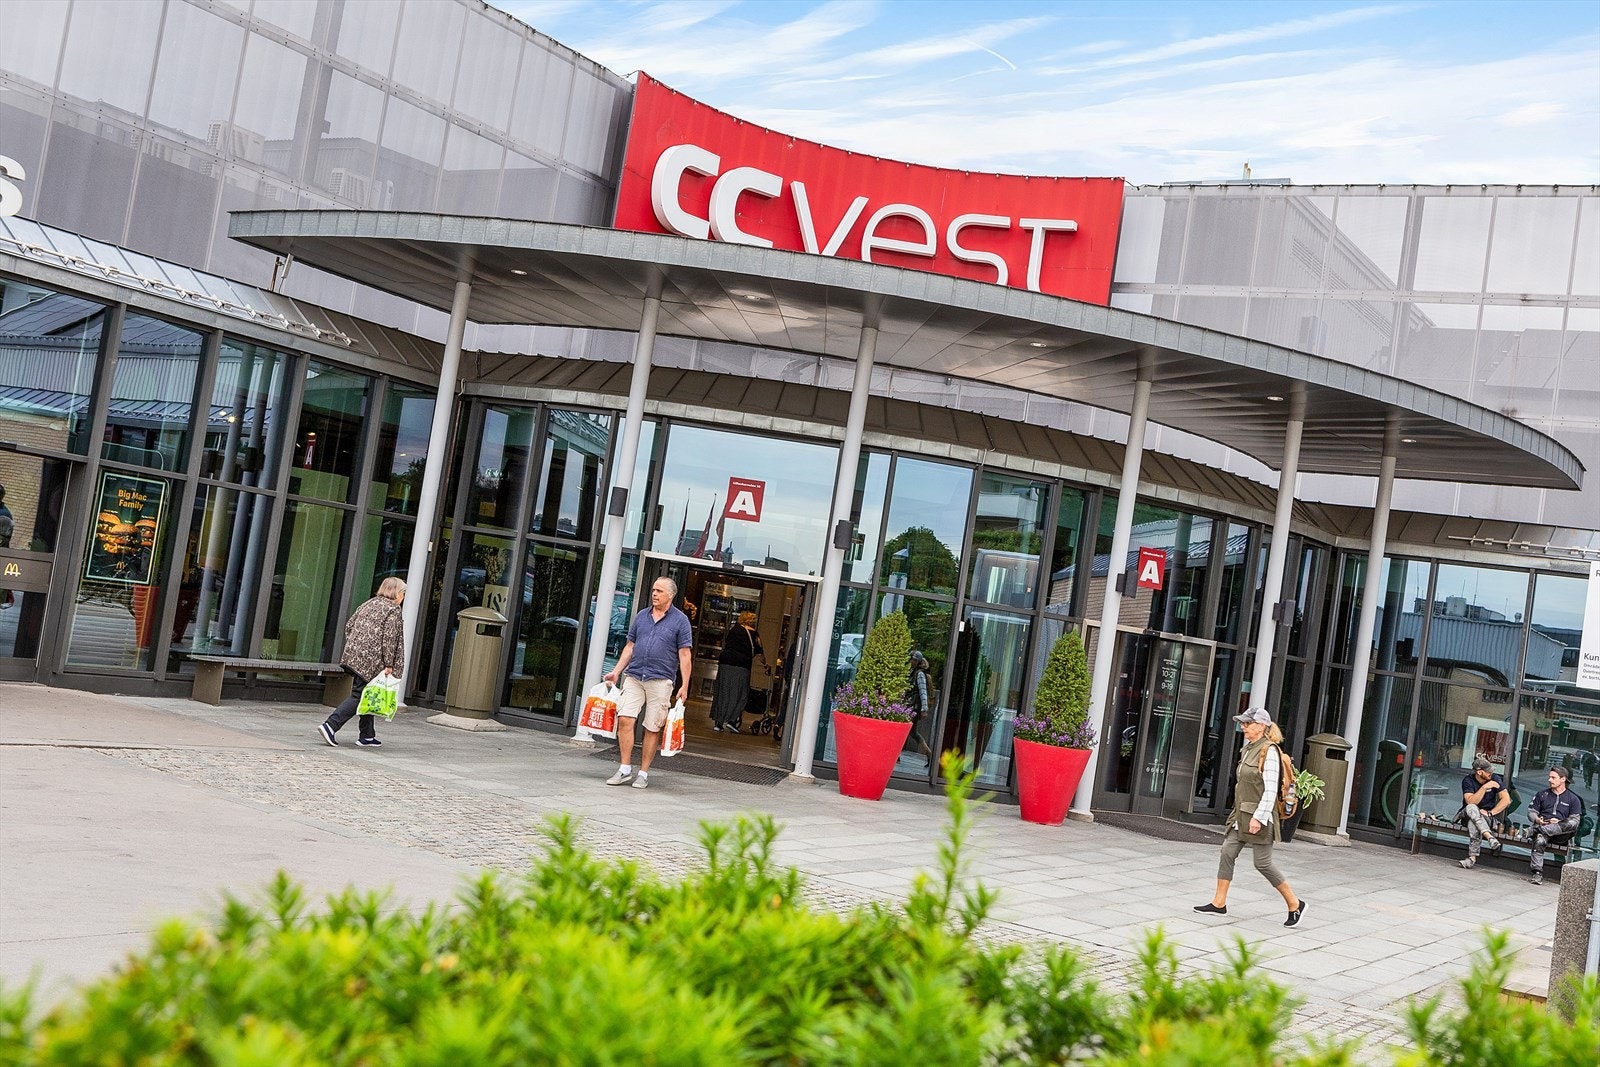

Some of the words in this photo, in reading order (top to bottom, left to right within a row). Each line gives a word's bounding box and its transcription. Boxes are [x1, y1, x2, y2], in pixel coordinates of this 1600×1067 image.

[118, 489, 130, 500] Big
[131, 491, 147, 501] Mac
[118, 499, 144, 511] Family
[729, 490, 757, 516] A
[1140, 560, 1160, 584] A
[1161, 670, 1176, 679] 10-21
[1161, 682, 1174, 690] 9-19
